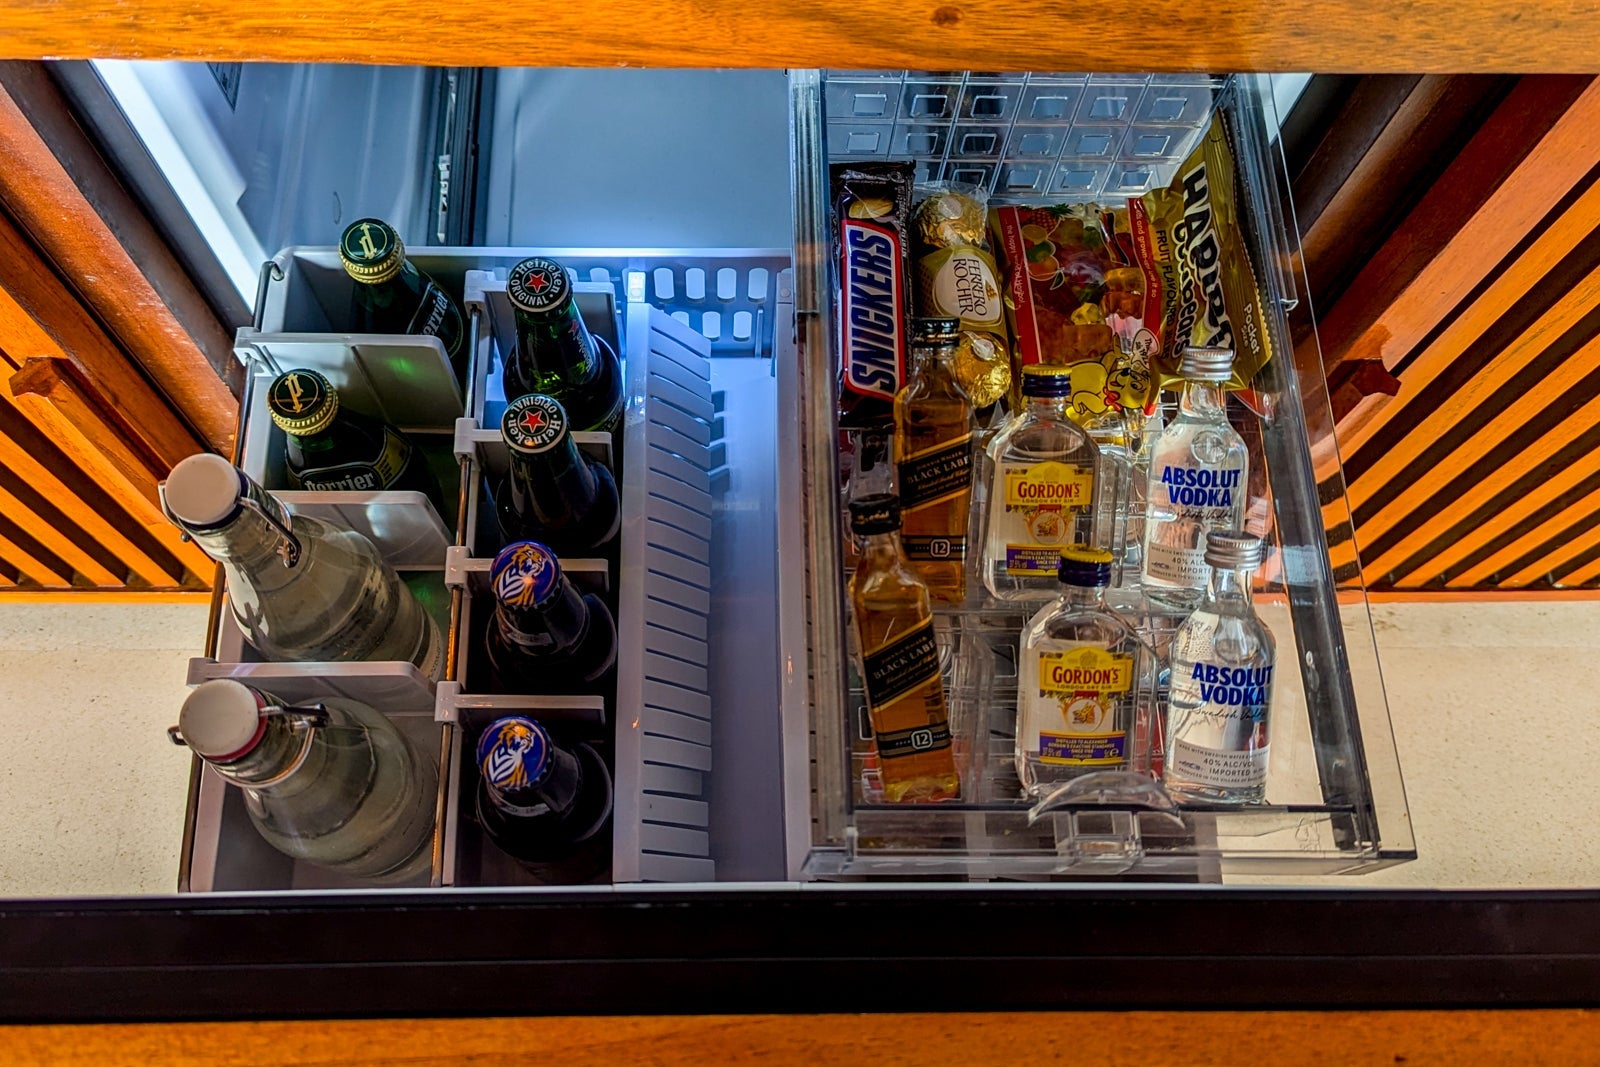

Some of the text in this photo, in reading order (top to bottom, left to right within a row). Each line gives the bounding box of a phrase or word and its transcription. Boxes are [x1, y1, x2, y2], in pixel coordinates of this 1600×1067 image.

[1136, 221, 1145, 234] and
[1155, 230, 1170, 262] FRUIT
[516, 258, 563, 294] Heineken
[953, 258, 974, 316] ROCHER
[967, 258, 987, 316] FERRERO
[510, 278, 550, 306] ORIGINAL
[1162, 265, 1177, 327] FLAVOURED
[849, 229, 896, 394] SNICKERS
[1244, 303, 1260, 355] Pocket
[511, 396, 558, 413] ORIGINAL
[508, 419, 561, 445] Heineken
[907, 467, 942, 484] BLACK
[1161, 466, 1241, 488] ABSOLUT
[1018, 481, 1081, 498] GORDON'S
[1168, 486, 1232, 507] VODKA
[934, 543, 947, 553] 12
[1172, 557, 1188, 565] 40%
[873, 656, 908, 680] BLACK
[1052, 666, 1119, 685] GORDON'S
[1192, 662, 1273, 687] ABSOLUT
[1200, 683, 1265, 707] VODKA
[915, 733, 929, 746] 12
[1203, 758, 1221, 767] 40%
[1209, 768, 1251, 776] IMPORTED
